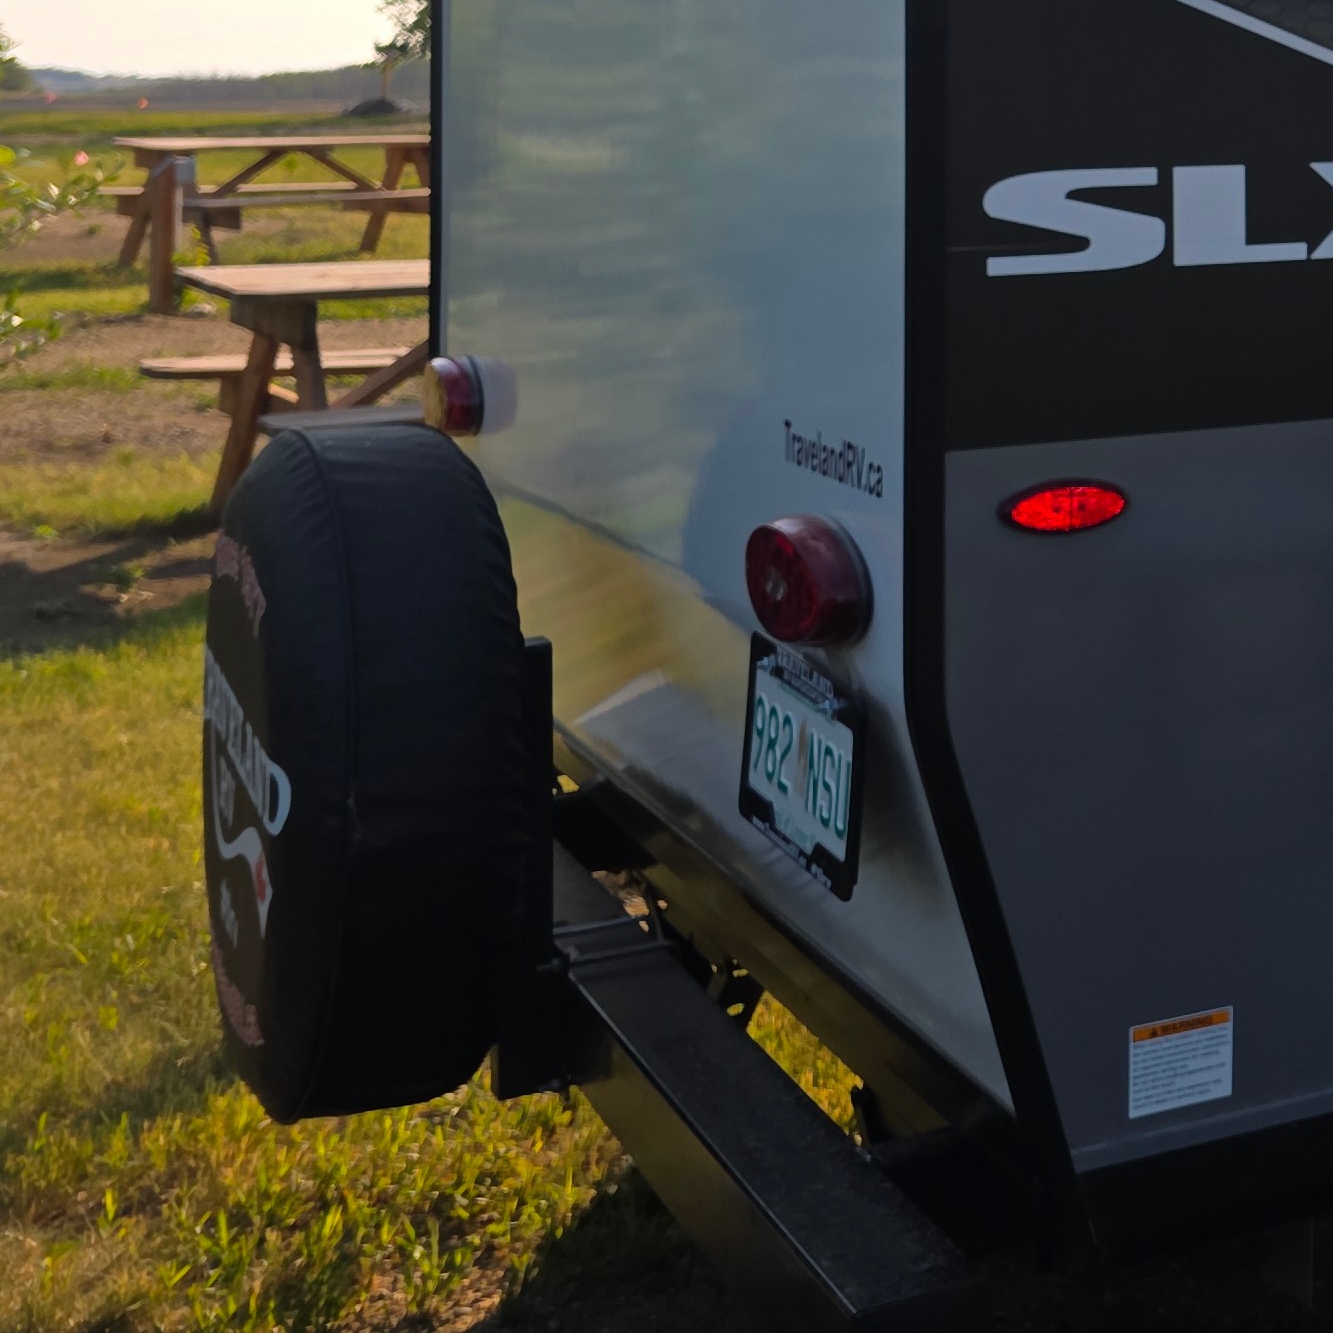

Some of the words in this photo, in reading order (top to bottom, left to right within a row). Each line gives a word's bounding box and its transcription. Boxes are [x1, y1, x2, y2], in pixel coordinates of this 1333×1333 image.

[783, 418, 884, 499] TravelandRV.ca
[753, 694, 794, 794] 982
[805, 731, 853, 840] NSU
